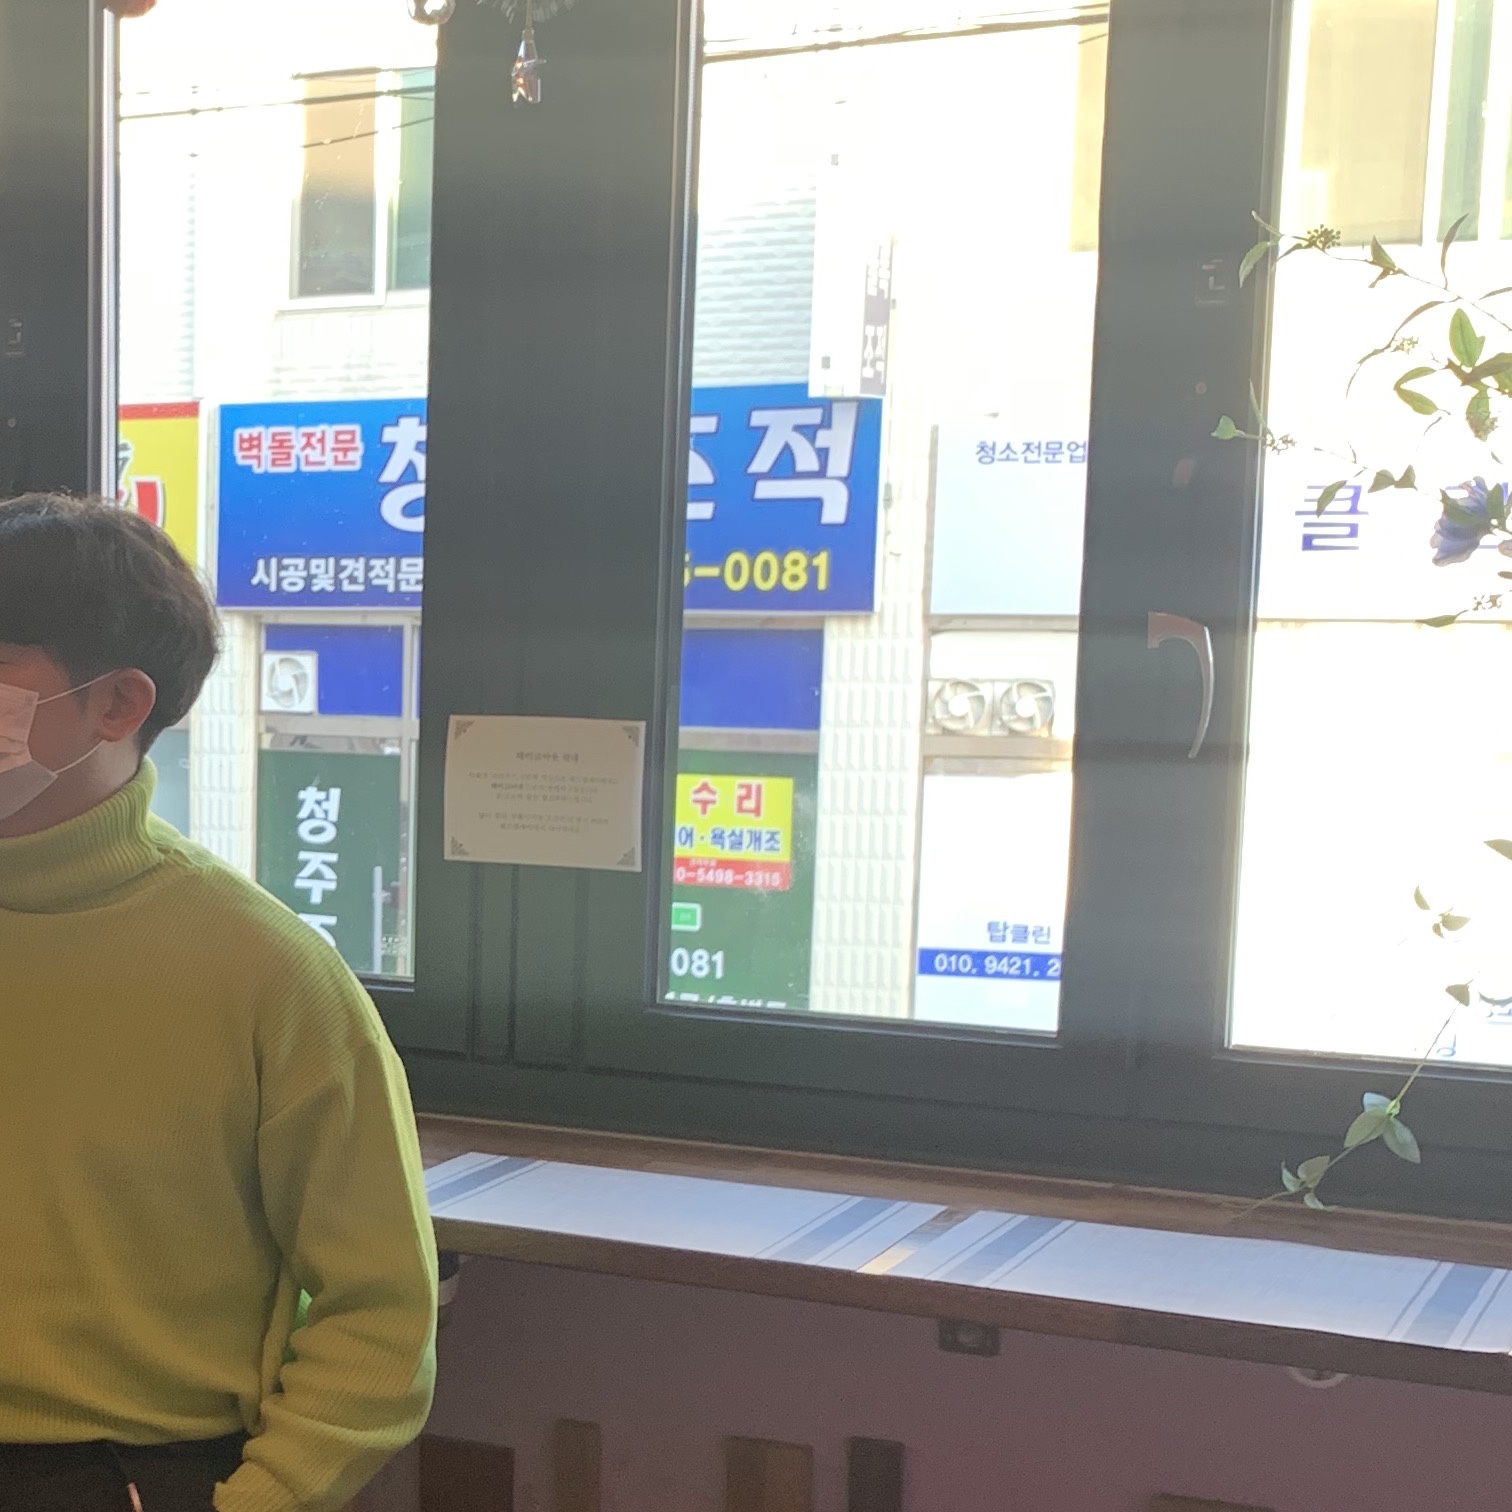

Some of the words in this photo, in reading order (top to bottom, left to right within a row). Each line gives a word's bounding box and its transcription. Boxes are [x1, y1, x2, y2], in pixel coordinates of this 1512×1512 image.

[236, 425, 361, 473] 벽돌전문
[975, 440, 1087, 466] 청소전문업
[987, 921, 1052, 944] 탑클린
